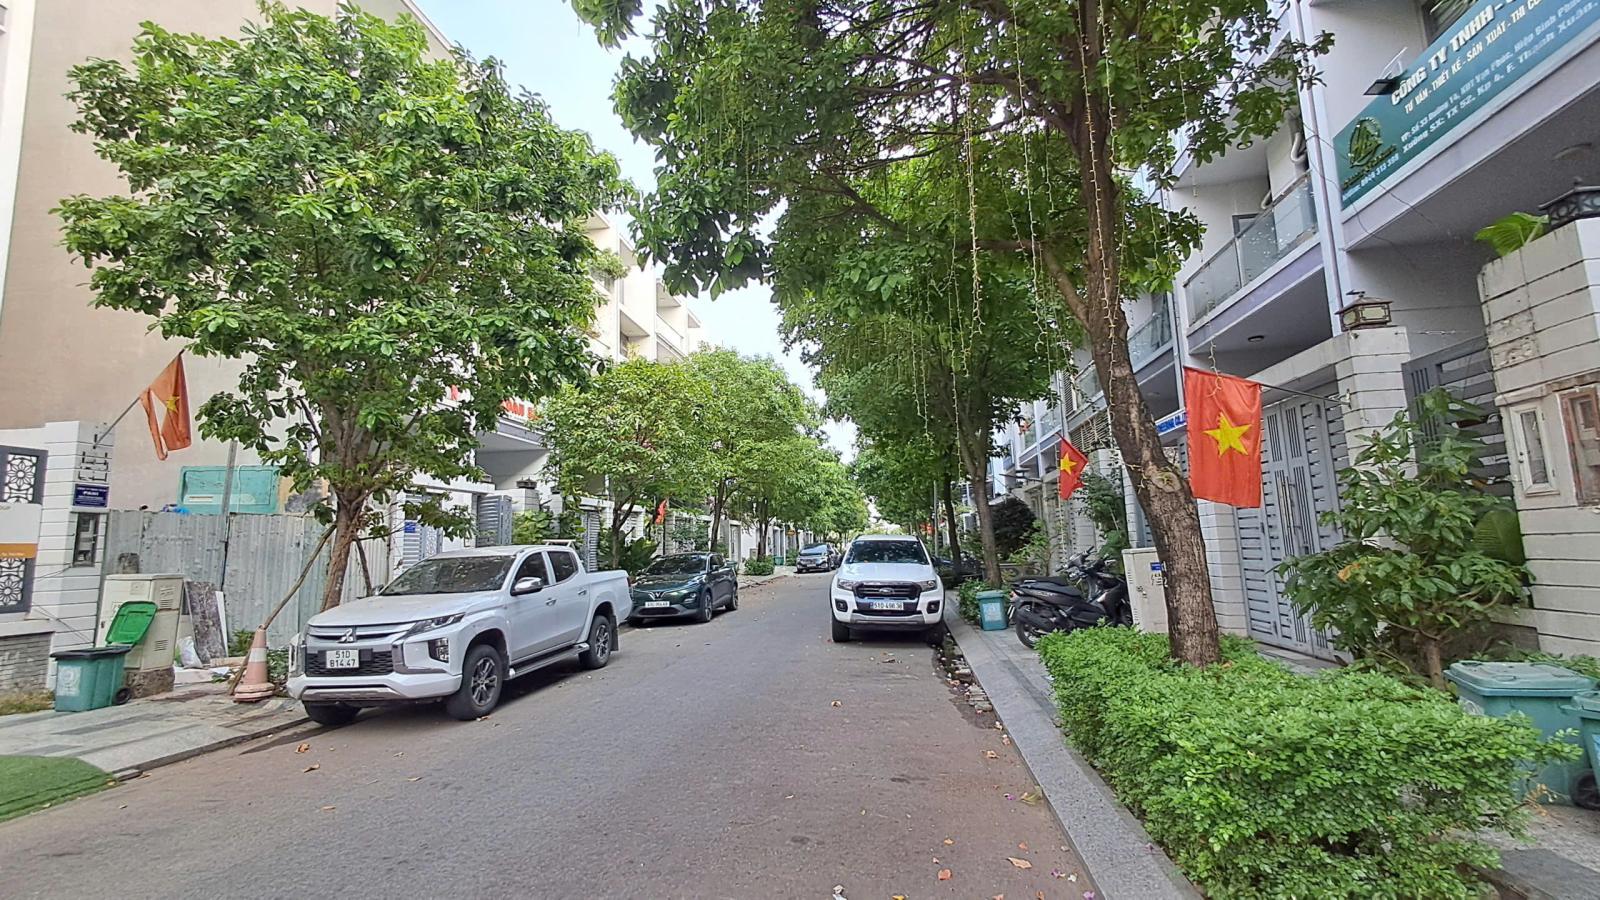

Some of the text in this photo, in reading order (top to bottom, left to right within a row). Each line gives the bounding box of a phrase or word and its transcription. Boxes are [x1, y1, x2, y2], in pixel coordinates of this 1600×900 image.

[1391, 66, 1426, 105] CÔNG
[1428, 46, 1448, 71] TY
[1449, 5, 1494, 52] TNHH
[1432, 68, 1449, 91] THIẾT
[1485, 21, 1506, 46] XUẤT
[1511, 5, 1526, 23] THI
